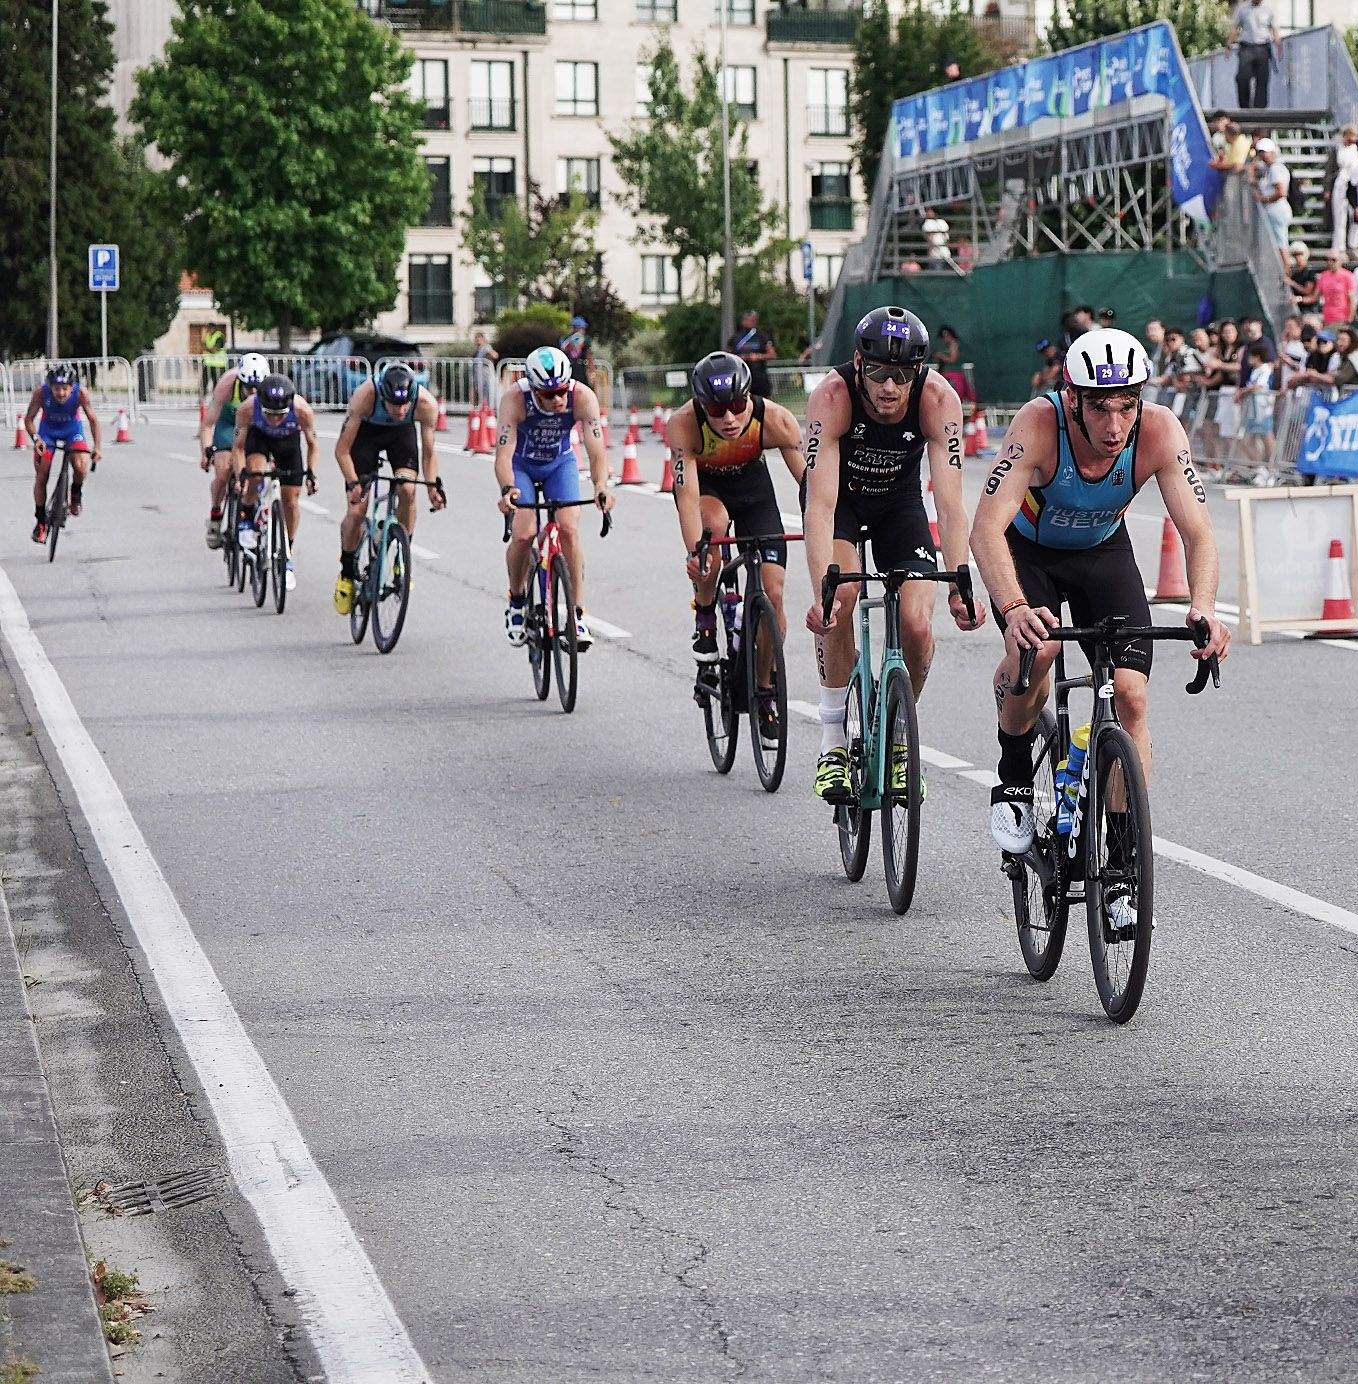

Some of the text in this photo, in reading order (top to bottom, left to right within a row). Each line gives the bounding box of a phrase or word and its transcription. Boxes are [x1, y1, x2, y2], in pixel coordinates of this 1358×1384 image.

[97, 250, 111, 268] P
[886, 323, 897, 332] 24
[1101, 368, 1113, 379] 29
[806, 437, 820, 470] 24
[948, 437, 962, 470] 24
[984, 458, 1013, 497] 29
[1183, 467, 1207, 504] 29
[1047, 505, 1119, 519] HUSTIN
[1050, 515, 1110, 529] BEL
